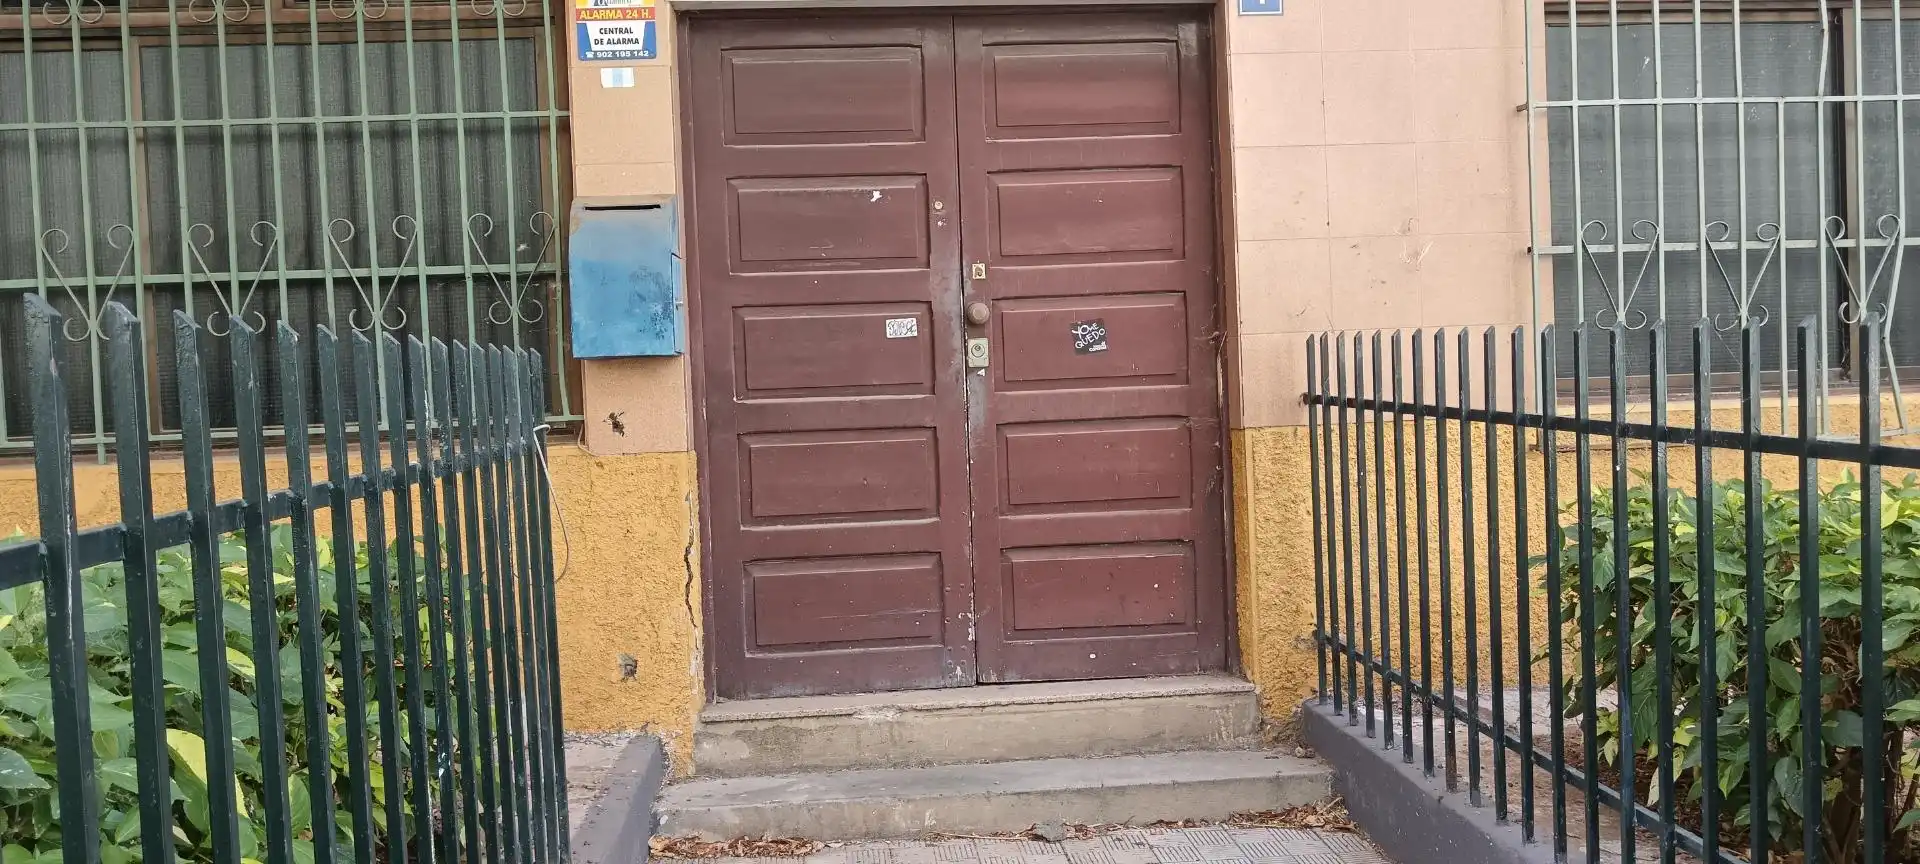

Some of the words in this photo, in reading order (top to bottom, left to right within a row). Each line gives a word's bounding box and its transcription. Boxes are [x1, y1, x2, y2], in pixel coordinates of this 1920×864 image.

[580, 9, 623, 19] ALARMA
[626, 9, 638, 19] 24
[641, 9, 651, 18] H.
[599, 27, 633, 35] CENTRAL
[606, 37, 639, 45] ALARMA
[1071, 325, 1089, 340] YO
[1075, 328, 1106, 349] QUEDO
